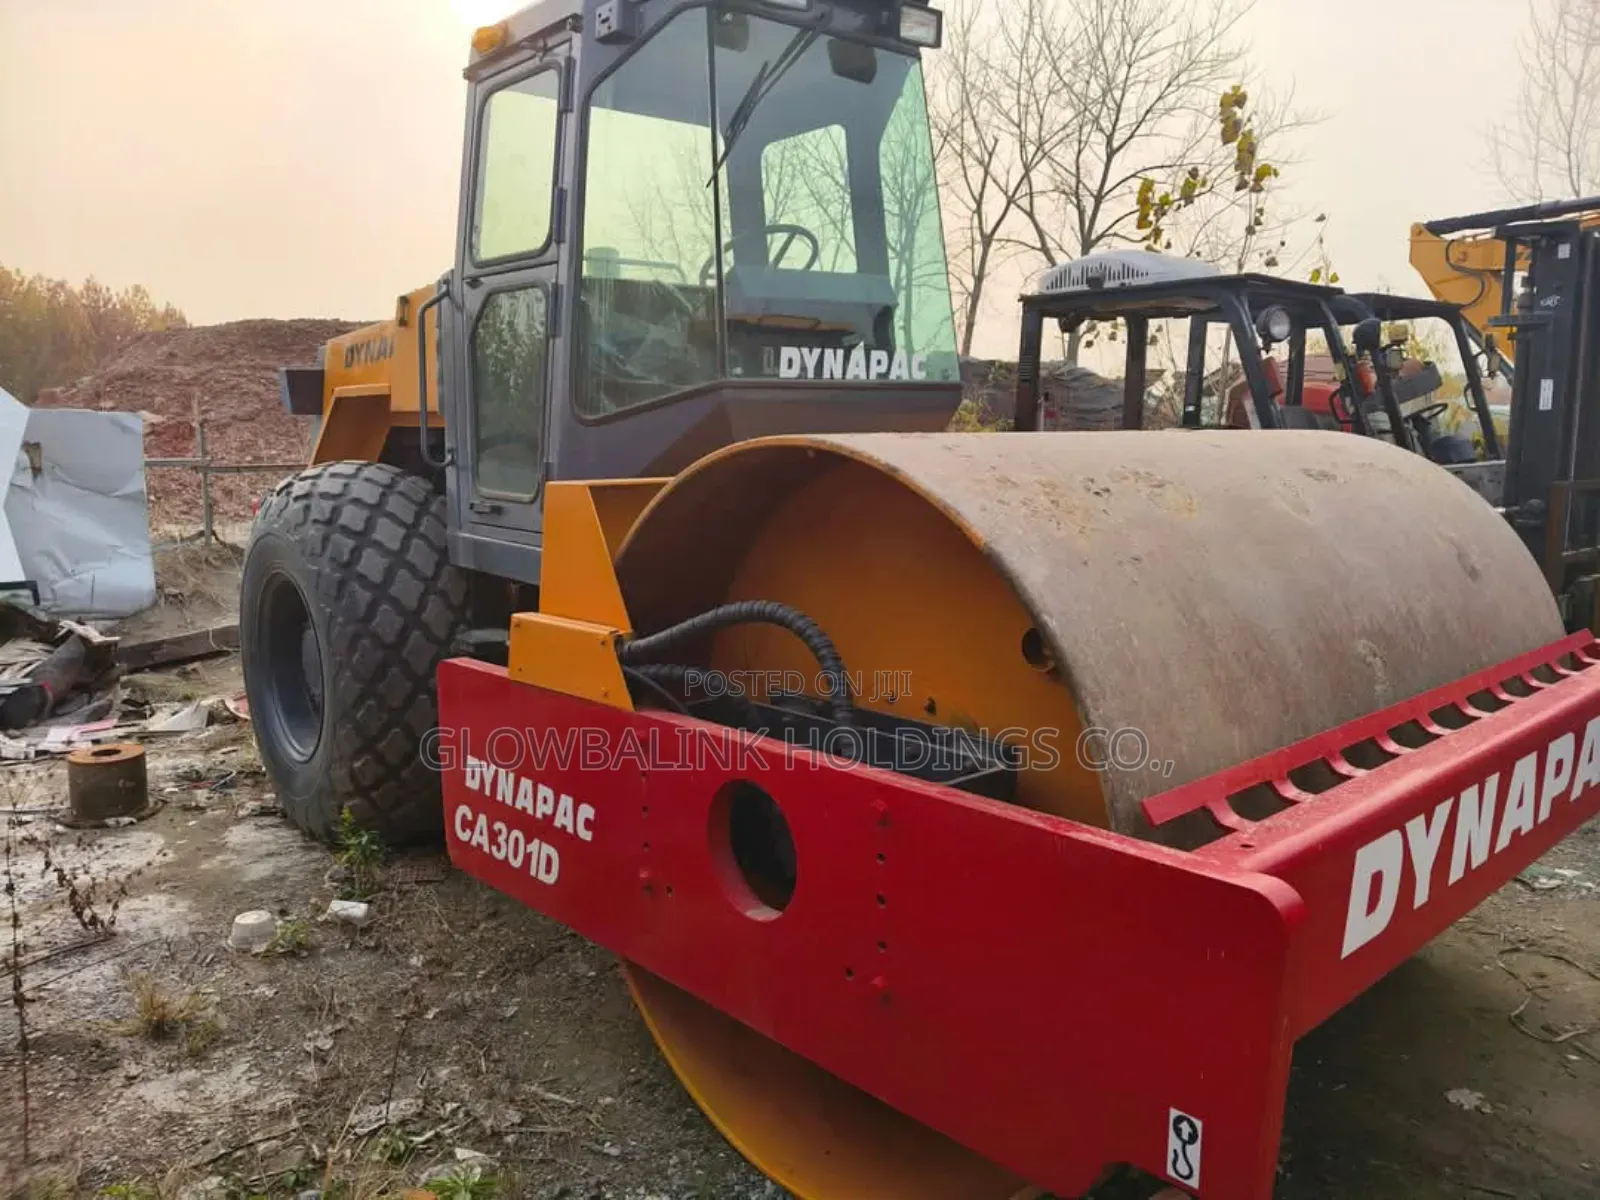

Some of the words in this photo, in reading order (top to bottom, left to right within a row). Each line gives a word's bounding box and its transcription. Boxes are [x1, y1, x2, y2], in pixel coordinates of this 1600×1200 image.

[779, 343, 927, 380] DYNAPAC
[465, 754, 596, 842] DYNAPAC
[454, 804, 560, 885] CA301D
